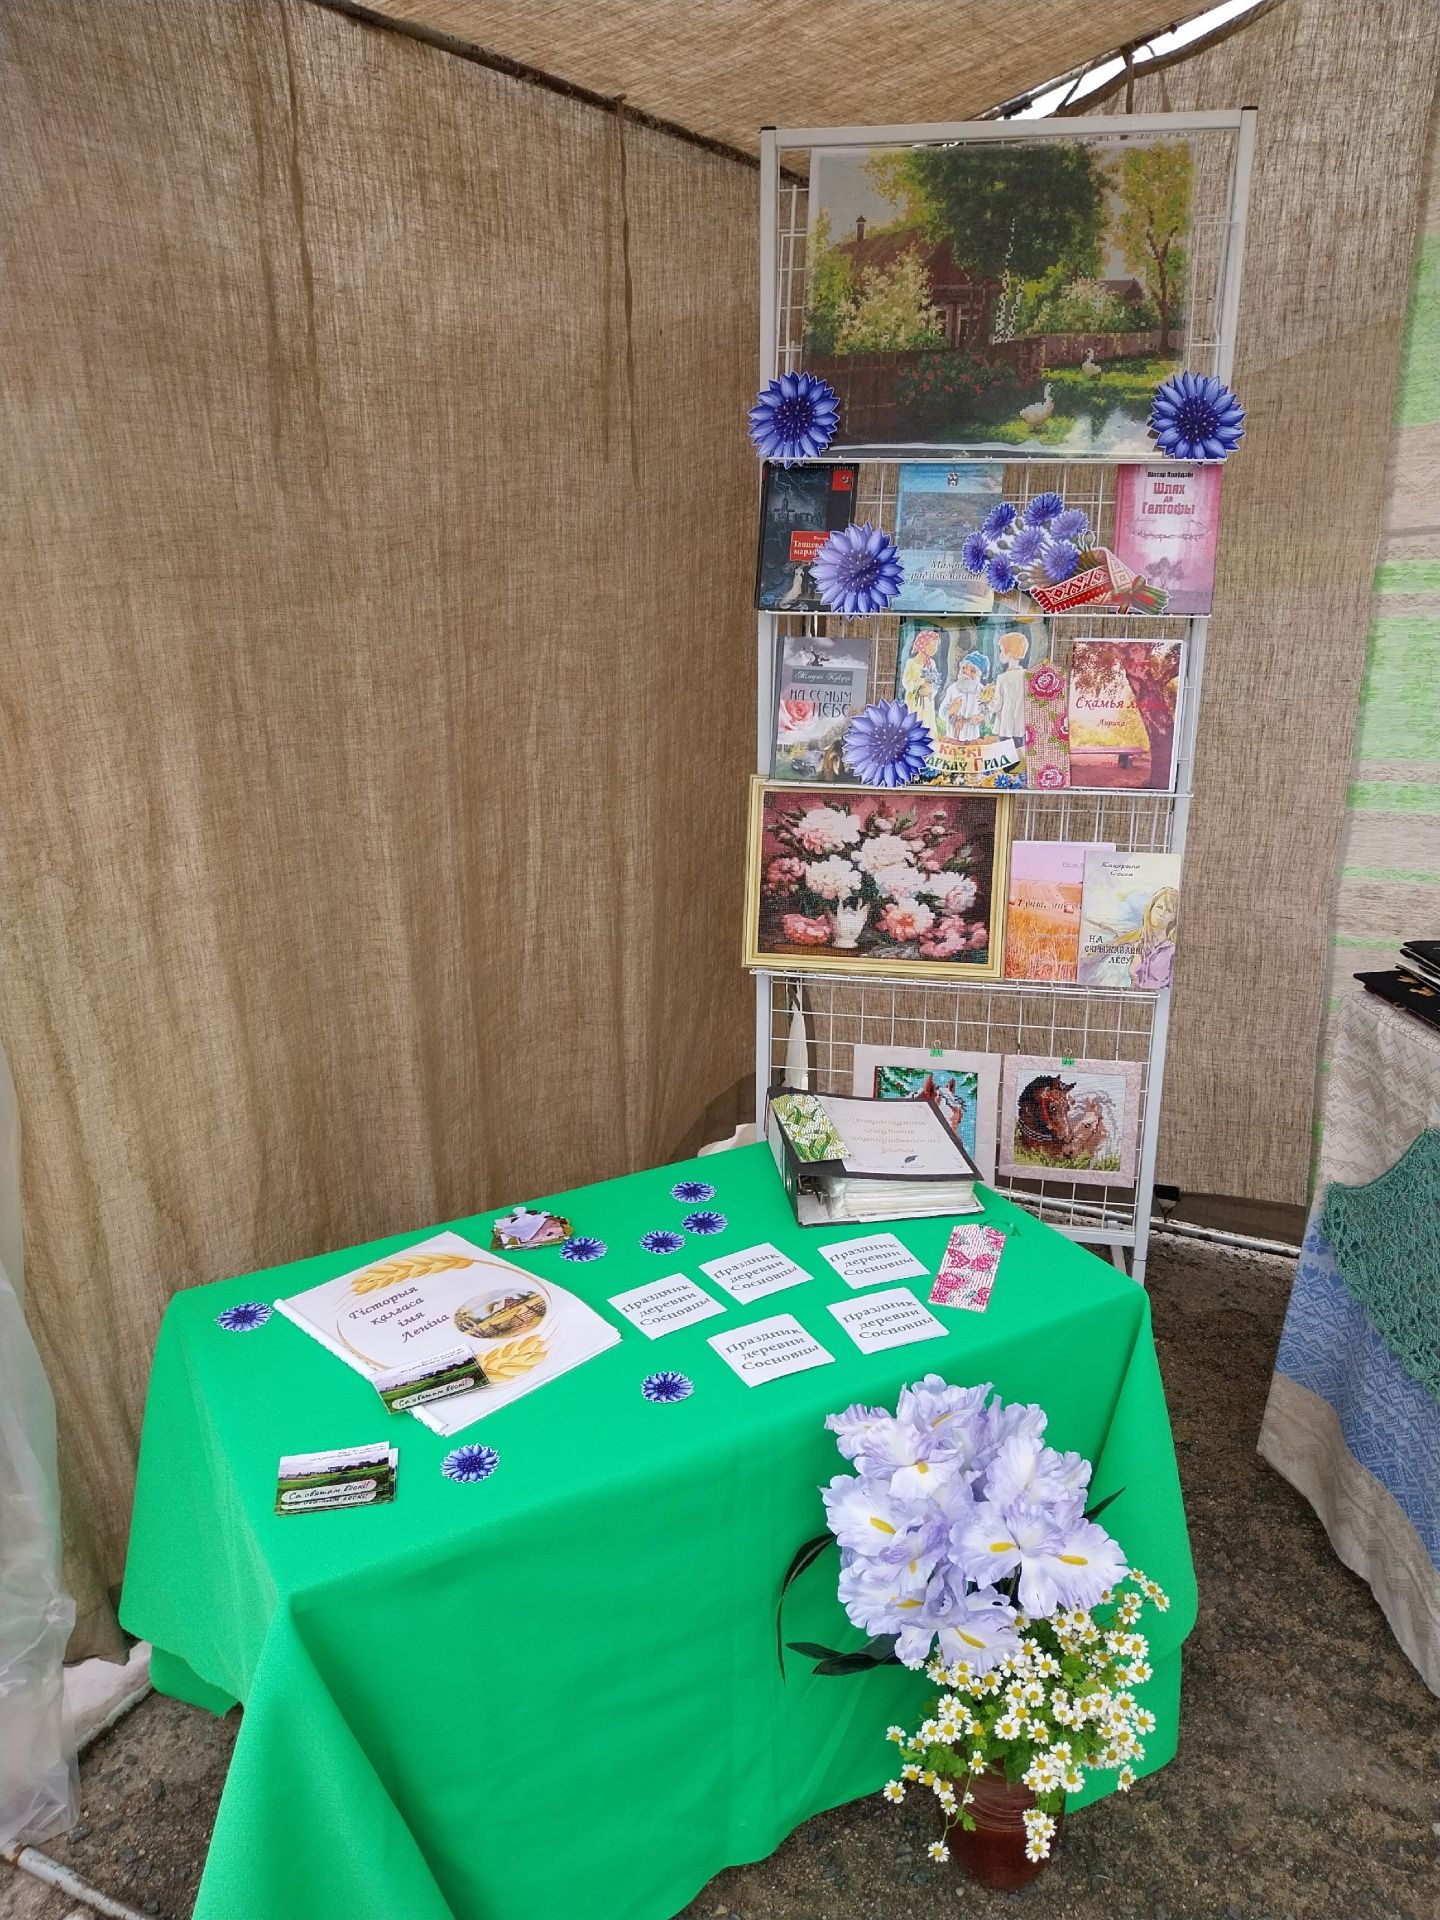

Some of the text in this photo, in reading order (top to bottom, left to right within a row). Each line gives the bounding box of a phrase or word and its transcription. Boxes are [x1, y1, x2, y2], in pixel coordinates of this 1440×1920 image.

[1153, 482, 1186, 495] Шлях
[1141, 502, 1196, 516] Галгофы
[812, 702, 852, 718] НЕБЕ
[1075, 694, 1125, 710] Скамья
[1097, 718, 1126, 728] Лирика
[1089, 934, 1104, 944] НА
[829, 1242, 898, 1263] Праздник
[844, 1249, 902, 1268] деревни
[713, 1252, 781, 1280] Праздник
[730, 1261, 785, 1284] деревни
[843, 1257, 915, 1276] Сосновцы
[730, 1265, 798, 1292] Сосновцы
[621, 1283, 691, 1315] Праздник
[639, 1292, 697, 1318] деревни
[639, 1296, 711, 1327] Сосновцы
[842, 1300, 917, 1323] Праздник
[859, 1308, 921, 1330] деревни
[401, 1314, 450, 1343] Леніна
[858, 1316, 934, 1340] Сосновцы
[725, 1326, 802, 1354] Праздник
[742, 1337, 806, 1360] деревни
[741, 1344, 820, 1371] Сосновцы
